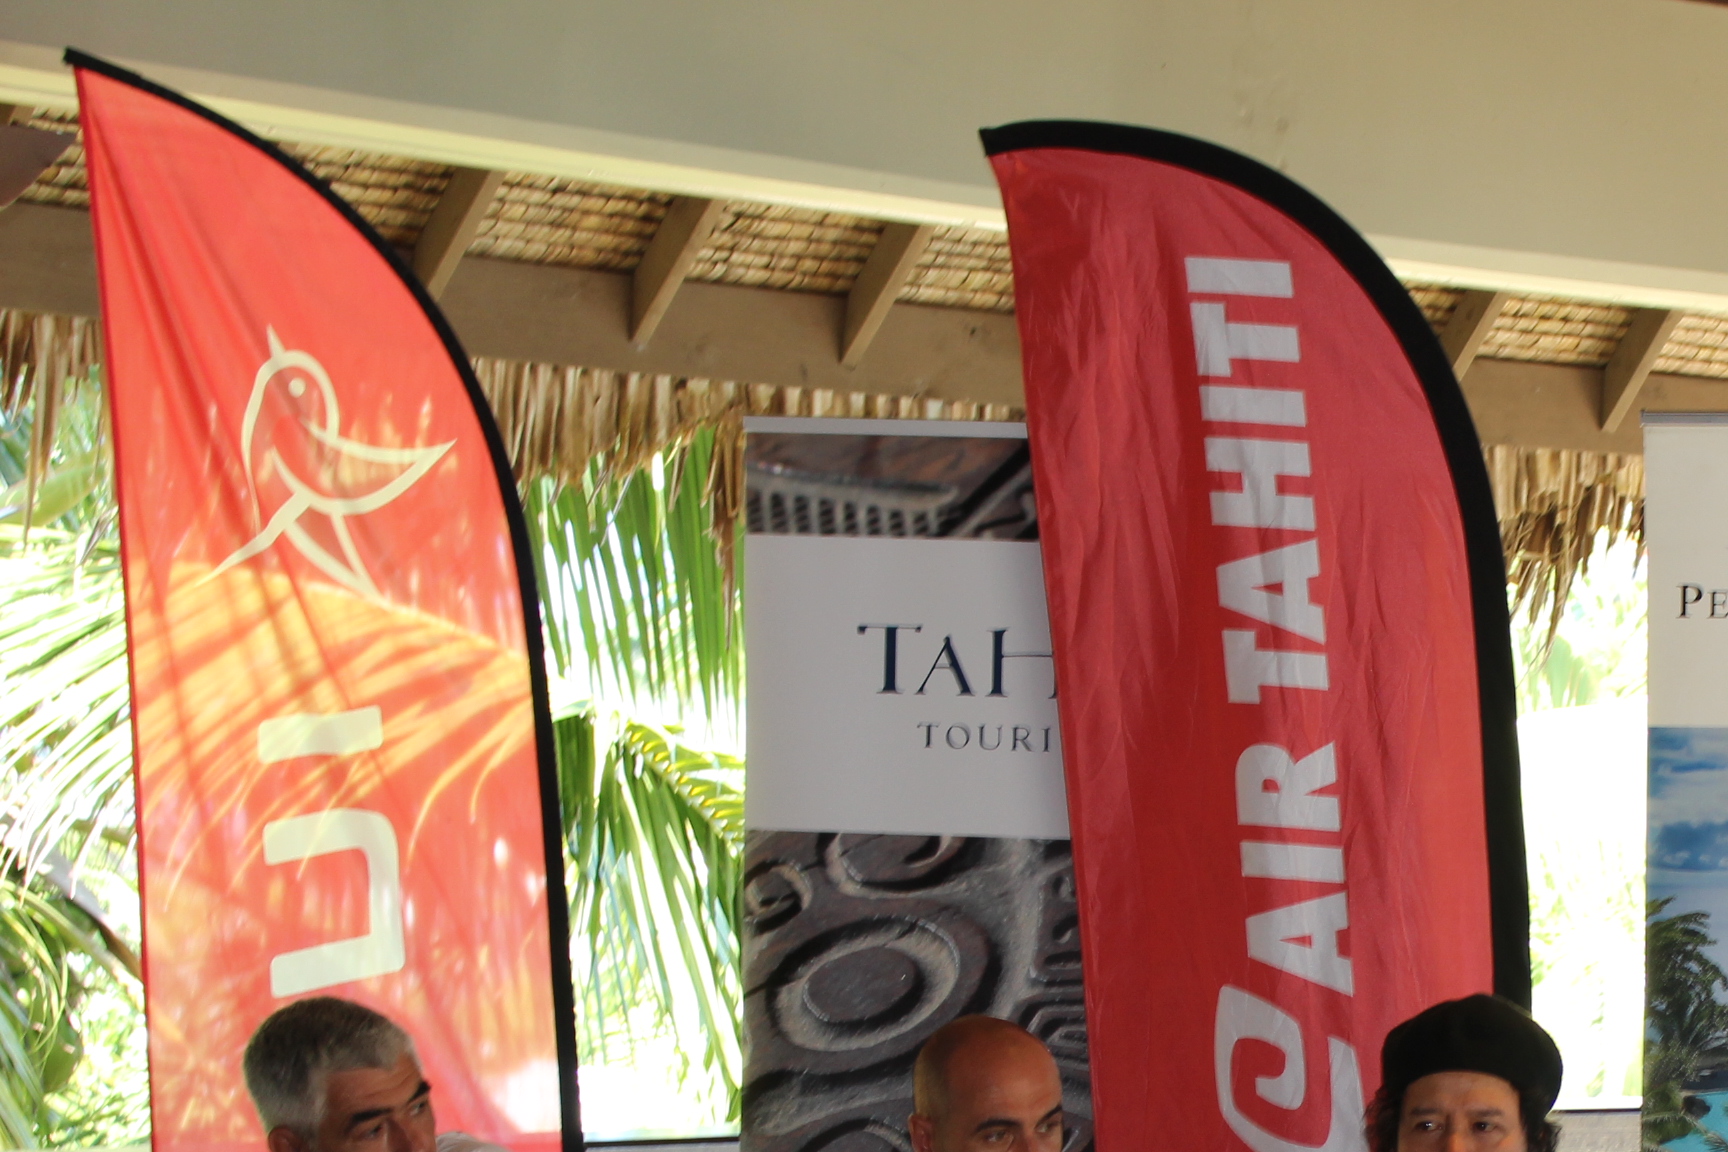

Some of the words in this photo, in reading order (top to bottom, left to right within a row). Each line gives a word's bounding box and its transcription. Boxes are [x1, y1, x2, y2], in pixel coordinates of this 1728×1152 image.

[1183, 256, 1331, 705] TAHITI
[856, 623, 1058, 701] TAH
[916, 721, 1052, 753] TOURI
[1235, 739, 1355, 998] AIR
